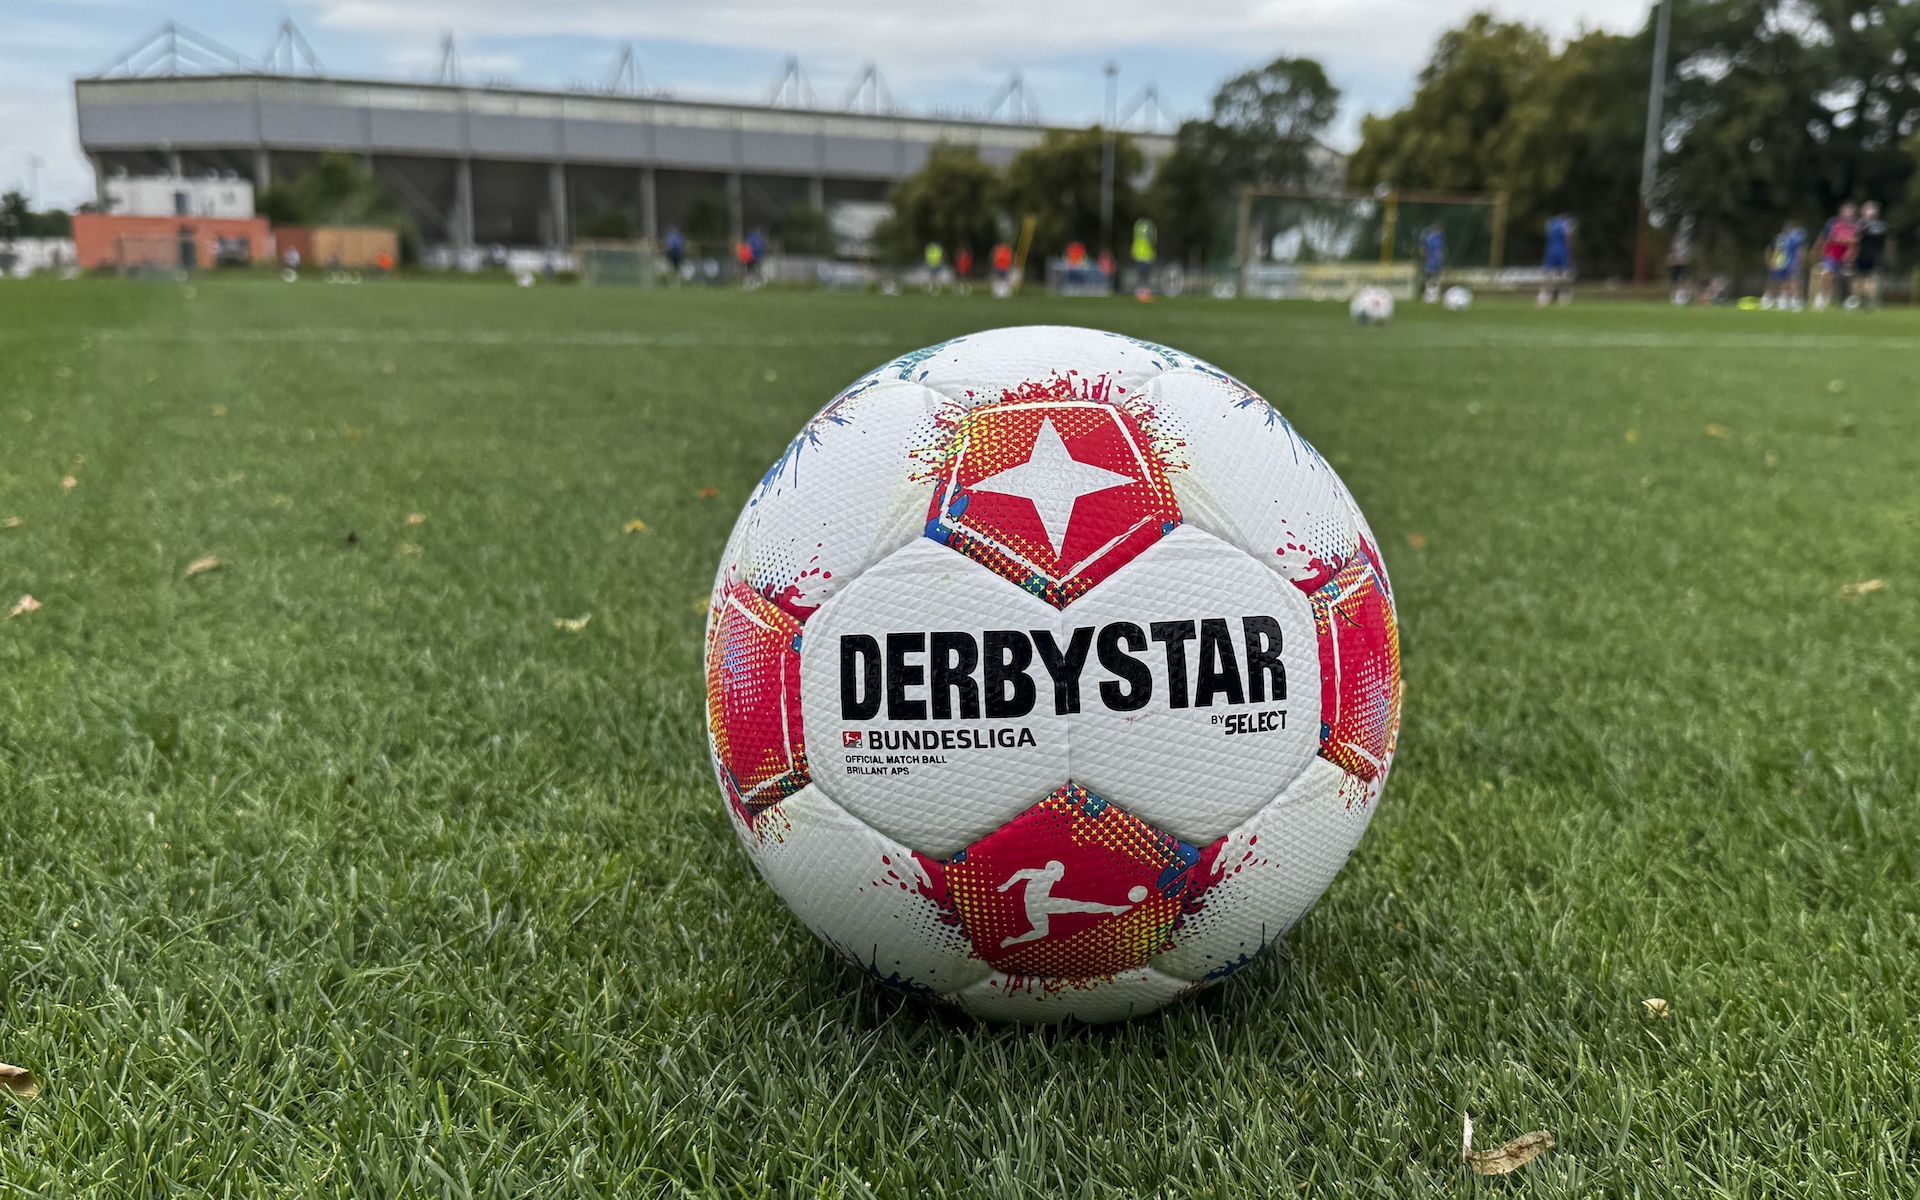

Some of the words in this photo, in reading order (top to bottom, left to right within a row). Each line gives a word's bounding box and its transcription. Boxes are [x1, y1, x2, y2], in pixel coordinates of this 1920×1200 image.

[840, 615, 1287, 721] DERBYSTAR
[1211, 715, 1224, 724] BY
[1225, 710, 1287, 735] SELECT
[868, 728, 1037, 750] BUNDESLIGA
[845, 755, 883, 764] OFFICIAL
[886, 755, 920, 764] MATCH
[922, 755, 947, 764] BALL
[846, 767, 888, 775] BRILLANT
[891, 767, 910, 775] APS
